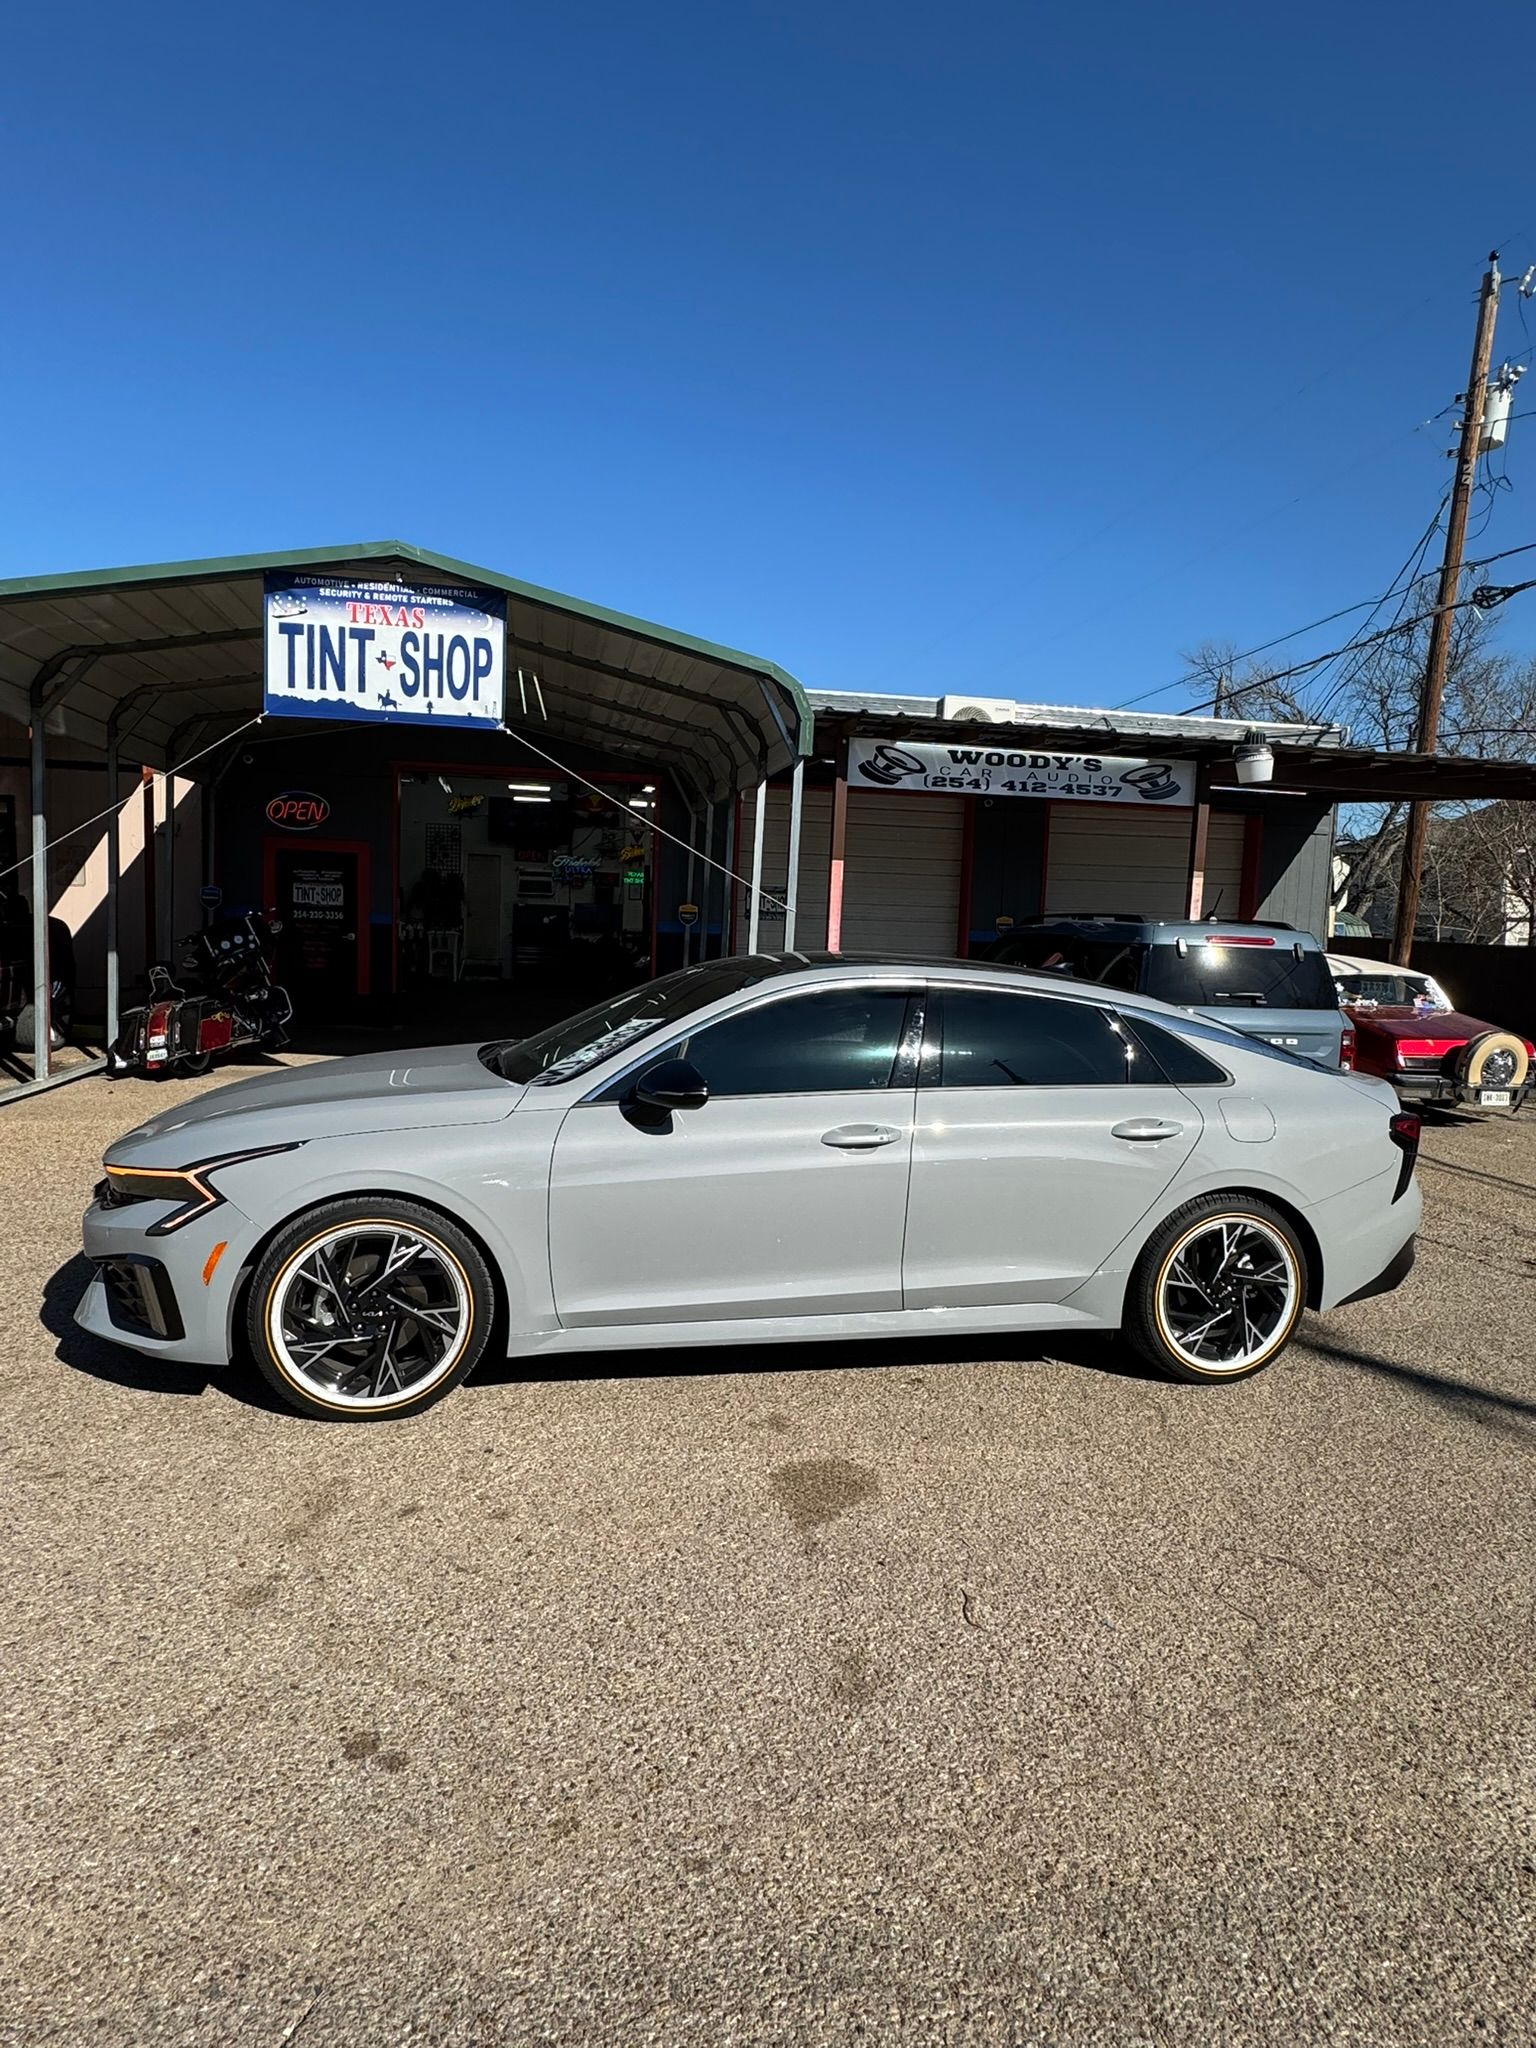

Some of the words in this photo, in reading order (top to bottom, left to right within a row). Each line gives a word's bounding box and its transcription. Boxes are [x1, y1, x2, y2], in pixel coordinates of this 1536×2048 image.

[294, 575, 350, 589] AUTOMOTIVE
[357, 581, 415, 595] RESIDENTIAL
[422, 586, 479, 600] COMMERCIAL
[319, 587, 363, 601] SECURITY
[364, 592, 371, 601] &
[373, 593, 409, 604] REMOTE
[410, 595, 455, 608] STARTERS
[346, 601, 426, 630] TEXAS
[278, 622, 376, 694] TINT
[399, 630, 494, 702] SHOP
[947, 749, 1103, 772] WOODY'S
[923, 773, 991, 792] (254)
[1000, 780, 1123, 799] 412-4537
[938, 765, 993, 779] CAR
[1026, 770, 1114, 786] AUDIO
[269, 800, 324, 821] OPEN
[320, 887, 342, 903] SHOP
